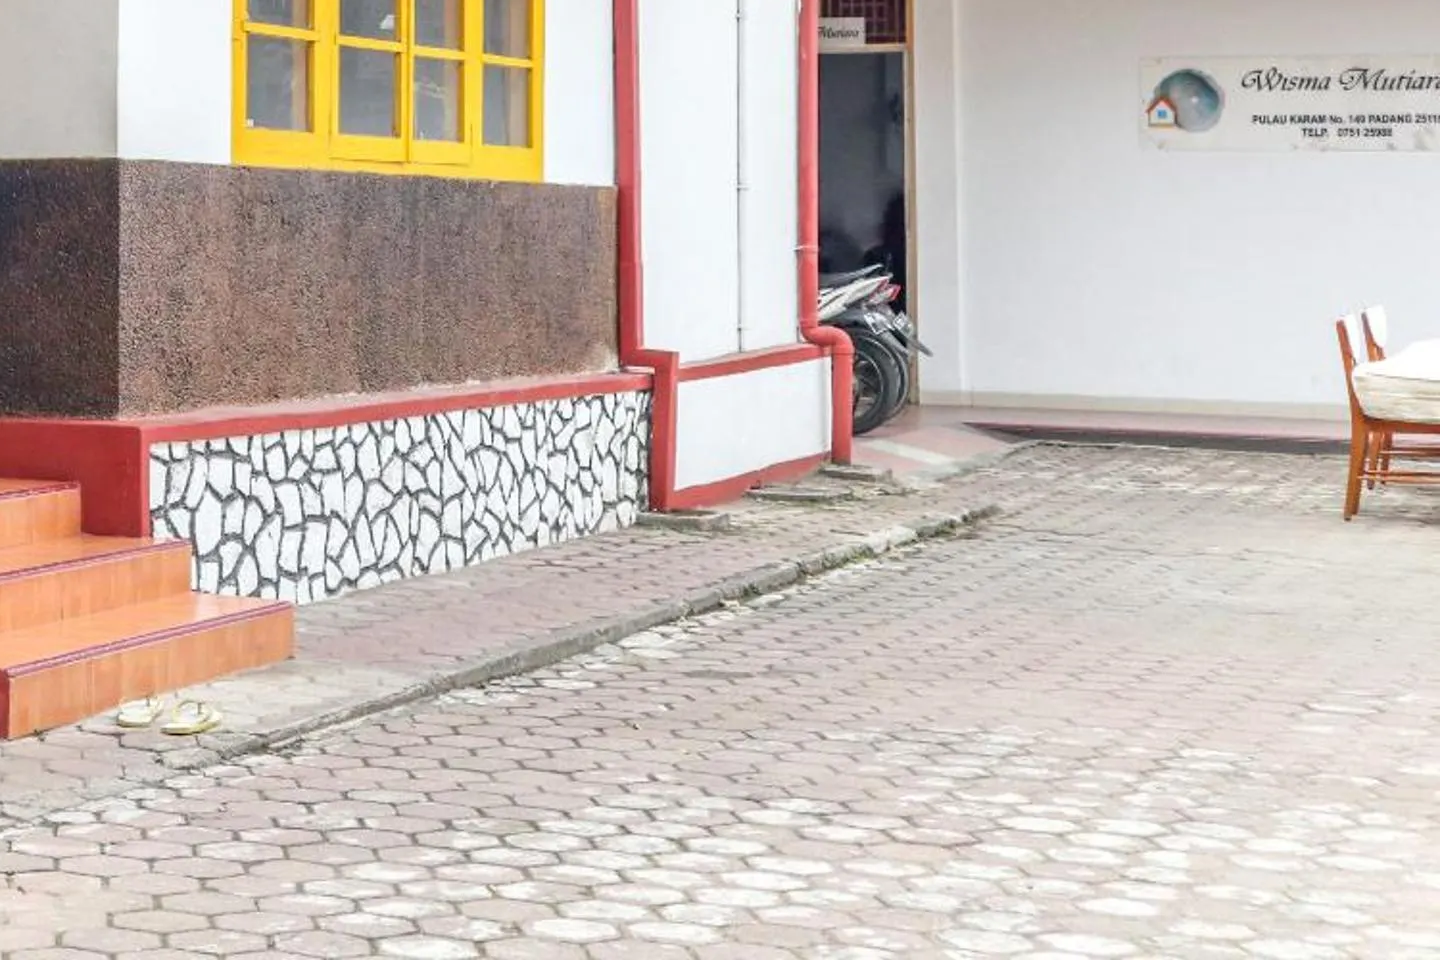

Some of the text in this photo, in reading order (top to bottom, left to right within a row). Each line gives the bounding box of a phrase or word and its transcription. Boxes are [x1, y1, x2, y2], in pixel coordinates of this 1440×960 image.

[1240, 66, 1331, 92] Wisma
[1251, 114, 1288, 125] PULAU
[1290, 114, 1327, 124] KARAM
[1348, 114, 1366, 124] 149
[1368, 113, 1412, 124] PADANG
